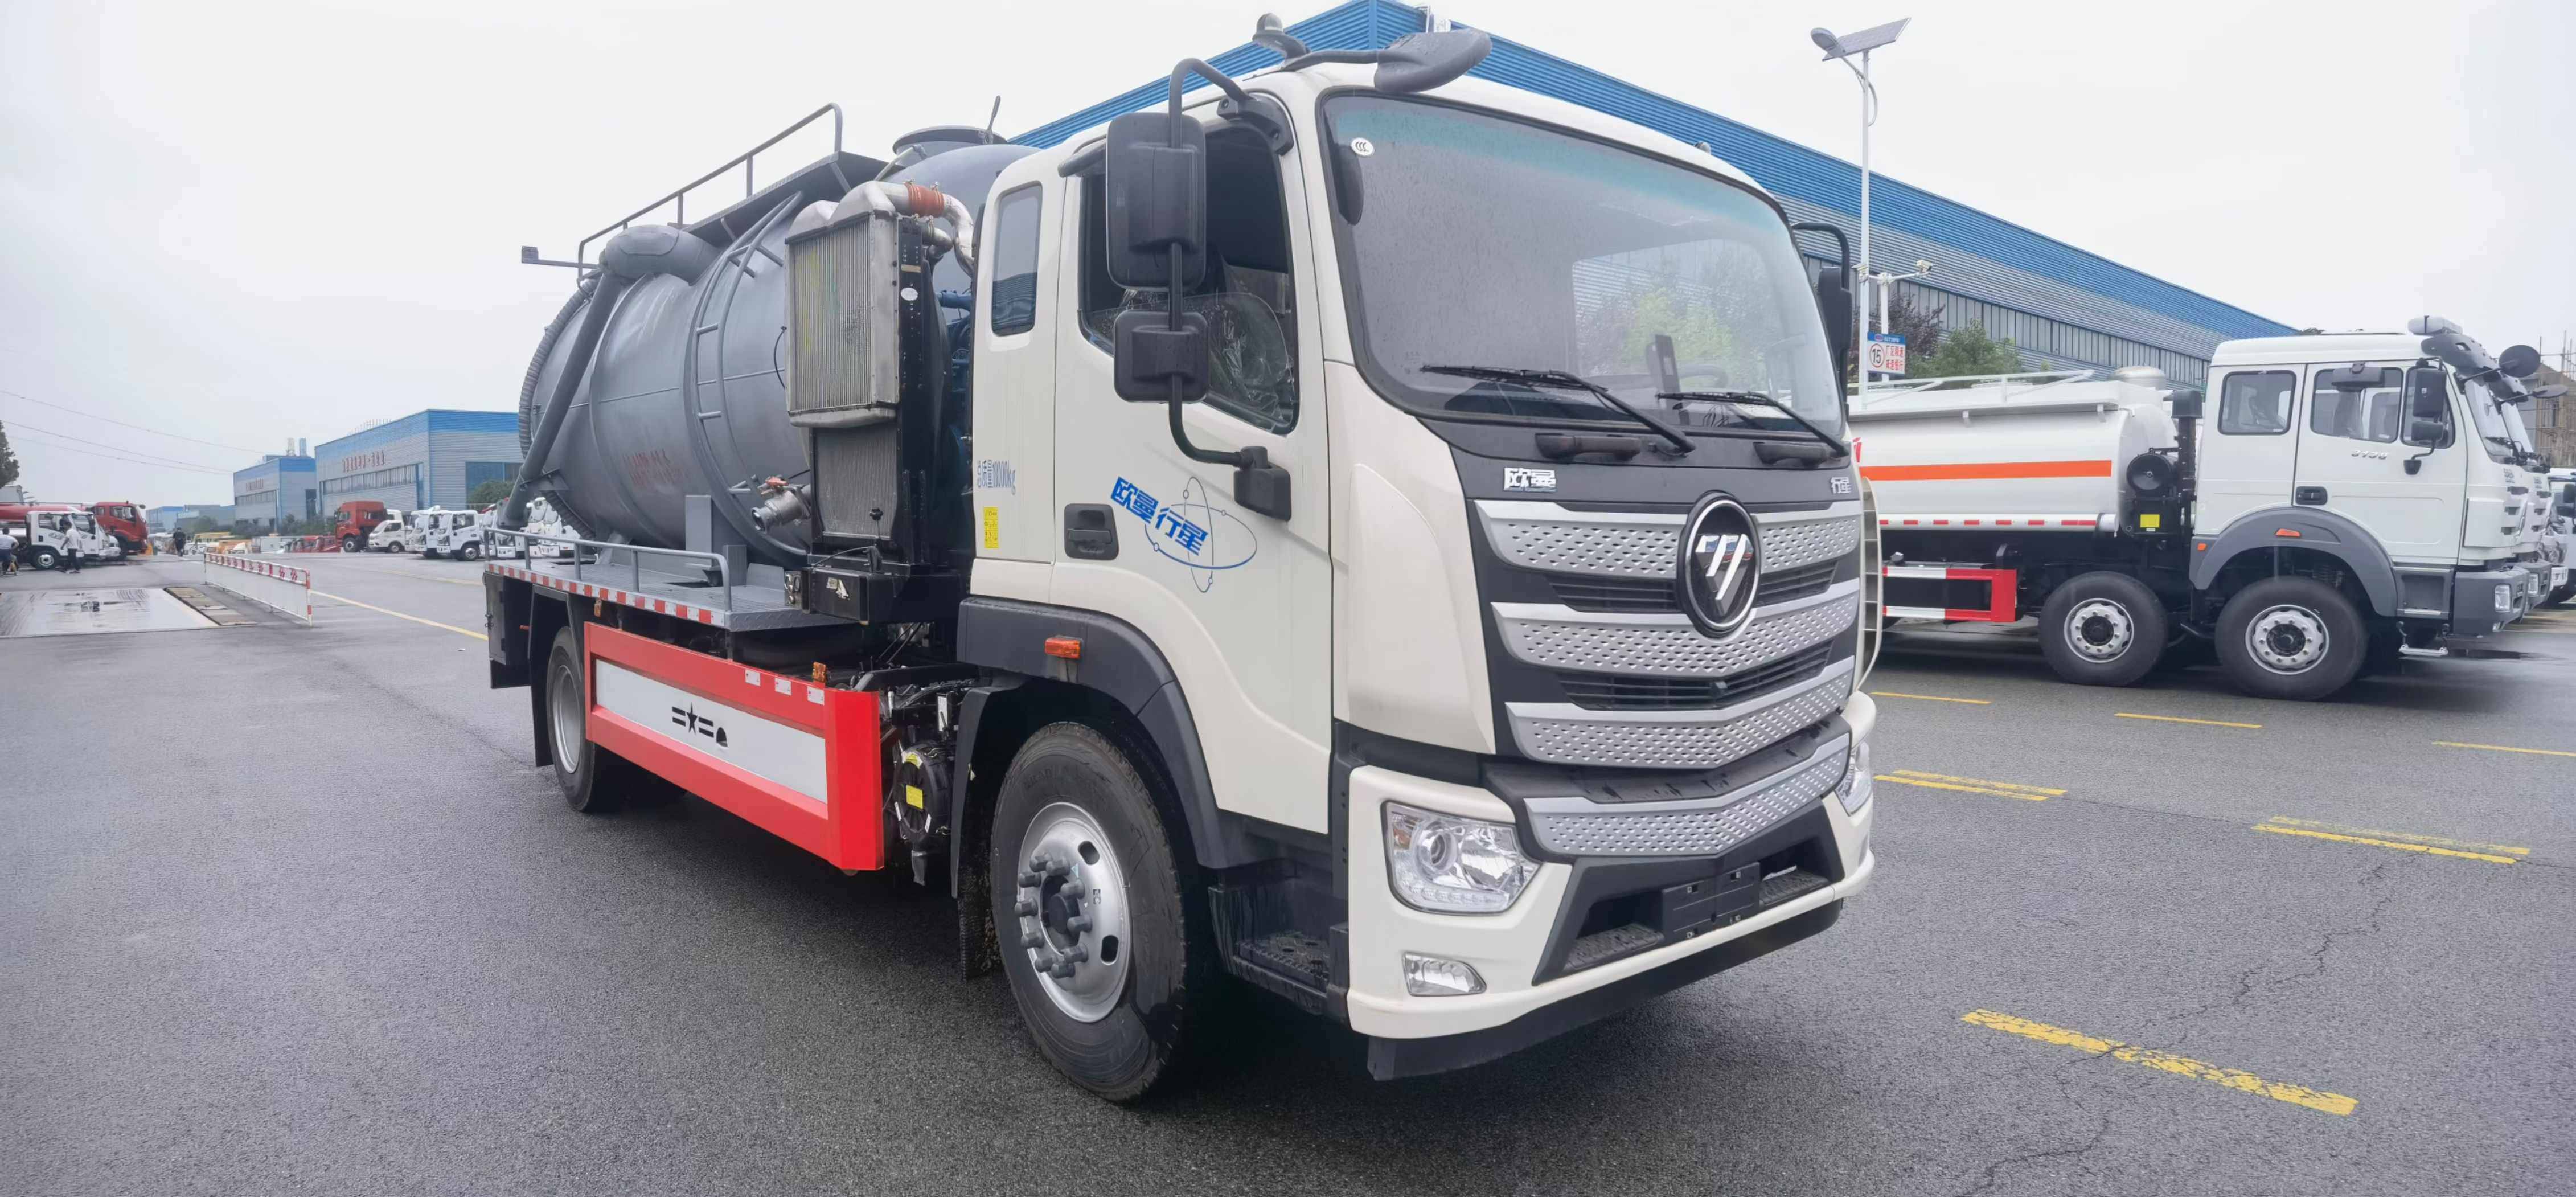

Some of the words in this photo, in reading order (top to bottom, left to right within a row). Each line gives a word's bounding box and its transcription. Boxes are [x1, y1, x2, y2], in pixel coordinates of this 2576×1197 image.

[1872, 348, 1881, 364] 15
[1503, 467, 1556, 492] 欧曼
[1831, 477, 1851, 494] 行星
[1110, 475, 1209, 556] 欧曼行星
